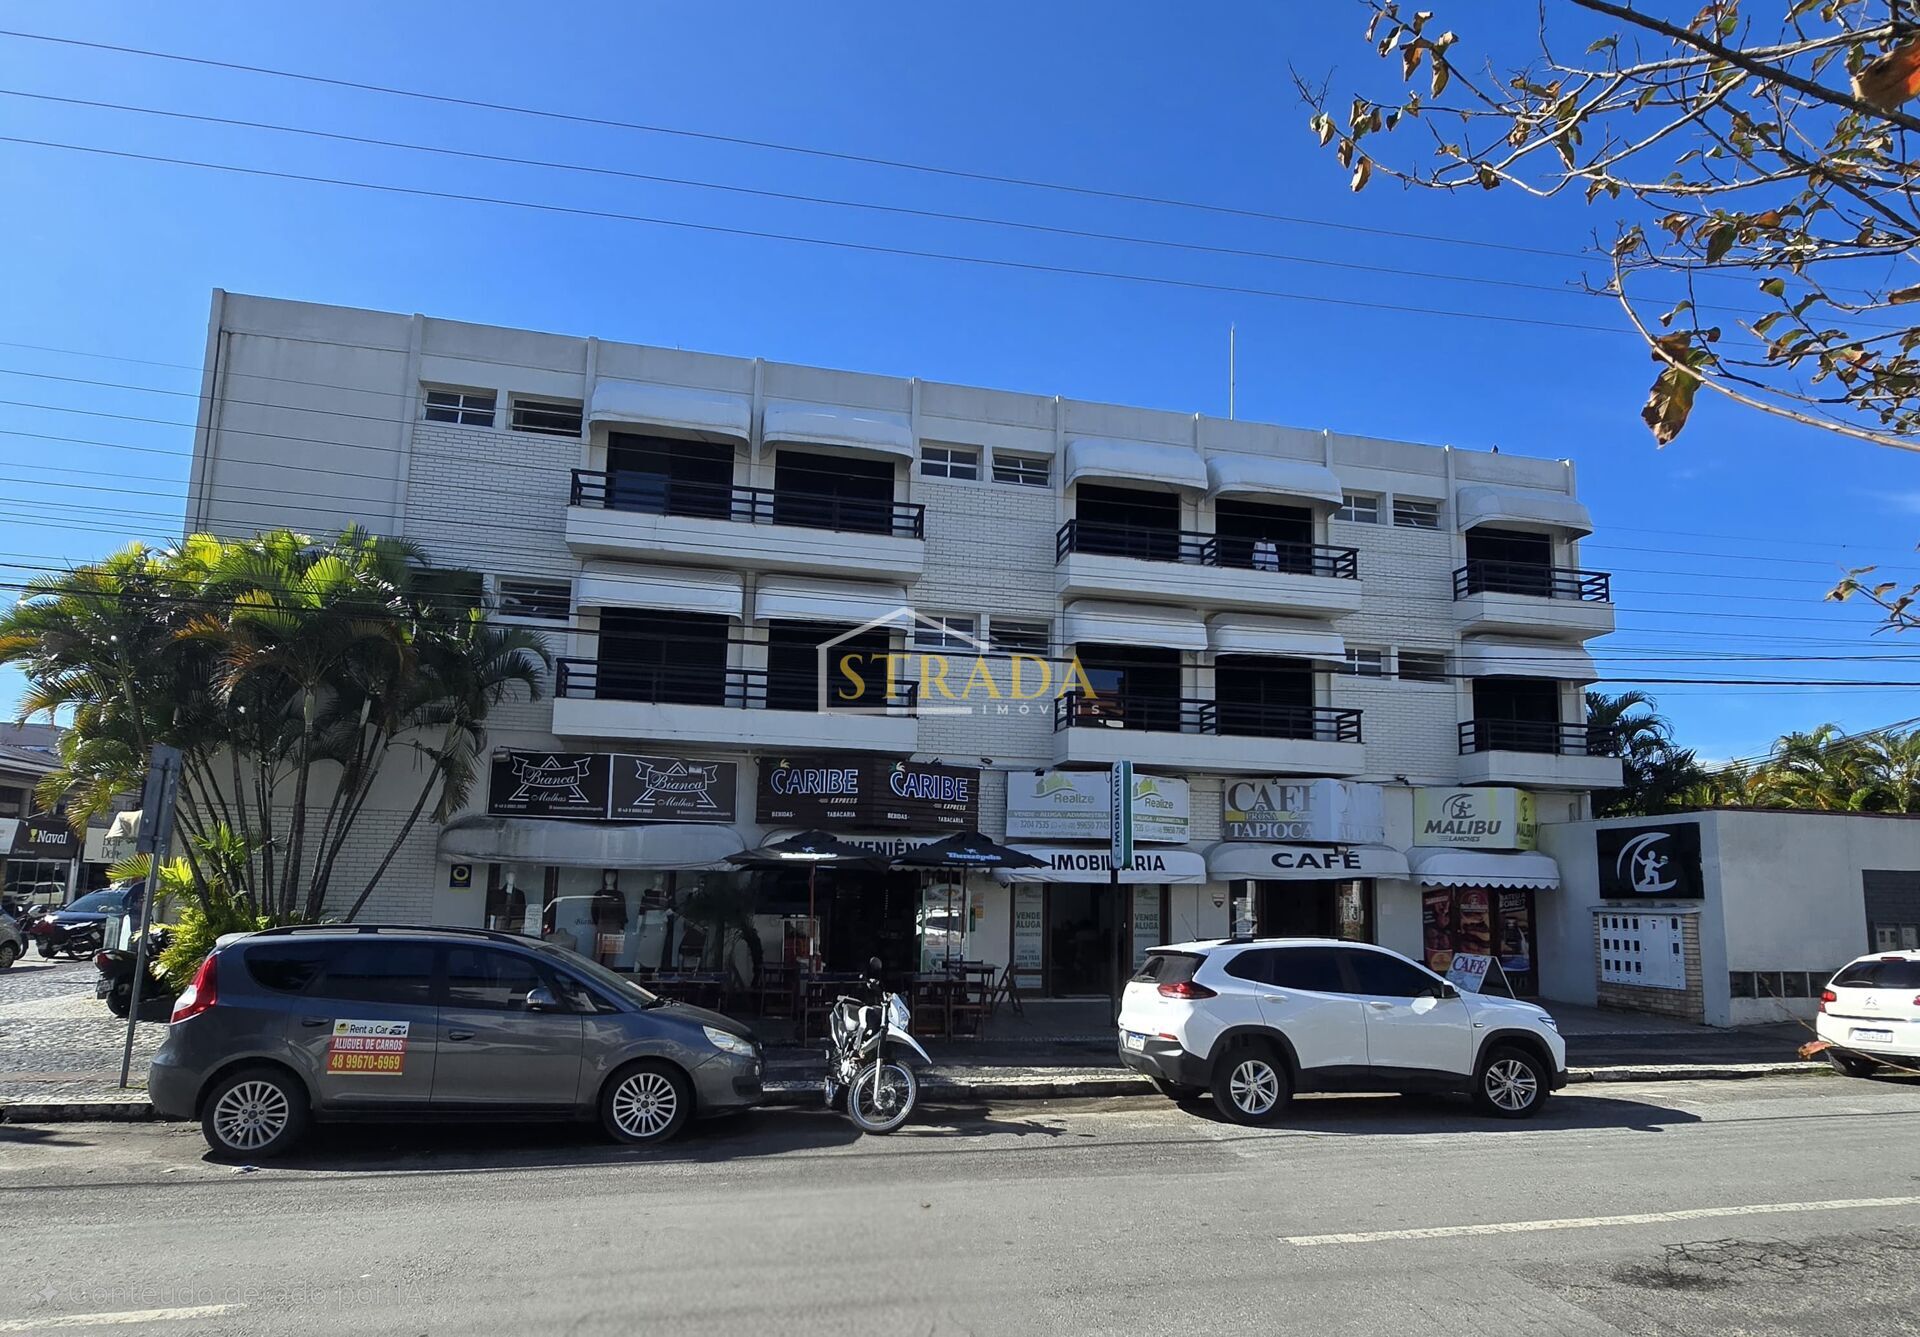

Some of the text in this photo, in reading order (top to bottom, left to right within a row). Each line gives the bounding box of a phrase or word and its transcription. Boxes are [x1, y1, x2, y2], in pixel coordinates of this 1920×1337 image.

[525, 768, 576, 785] Bianca
[650, 773, 704, 790] Bianca
[770, 768, 859, 794] CARIBE
[889, 771, 969, 802] CARIBE
[530, 792, 567, 802] Malhas
[657, 796, 695, 807] Malhas
[1054, 793, 1095, 804] Realize
[943, 803, 967, 811] EXPRESS
[1144, 798, 1174, 809] Realize
[938, 816, 964, 824] TABACARIA
[1424, 820, 1502, 835] MALIBU
[37, 830, 68, 844] Naval
[1271, 851, 1362, 869] CAFÉ
[1016, 911, 1040, 920] VENDE
[1135, 913, 1158, 921] VENDE
[1016, 920, 1041, 928] ALUGA
[1135, 921, 1159, 929] ALUGA
[1453, 956, 1487, 975] CAFÉ
[350, 1024, 367, 1034] Rent
[375, 1025, 388, 1034] Car
[334, 1037, 403, 1051] ALUGUEL DE CARROS
[332, 1054, 400, 1070] 48 99670-6969
